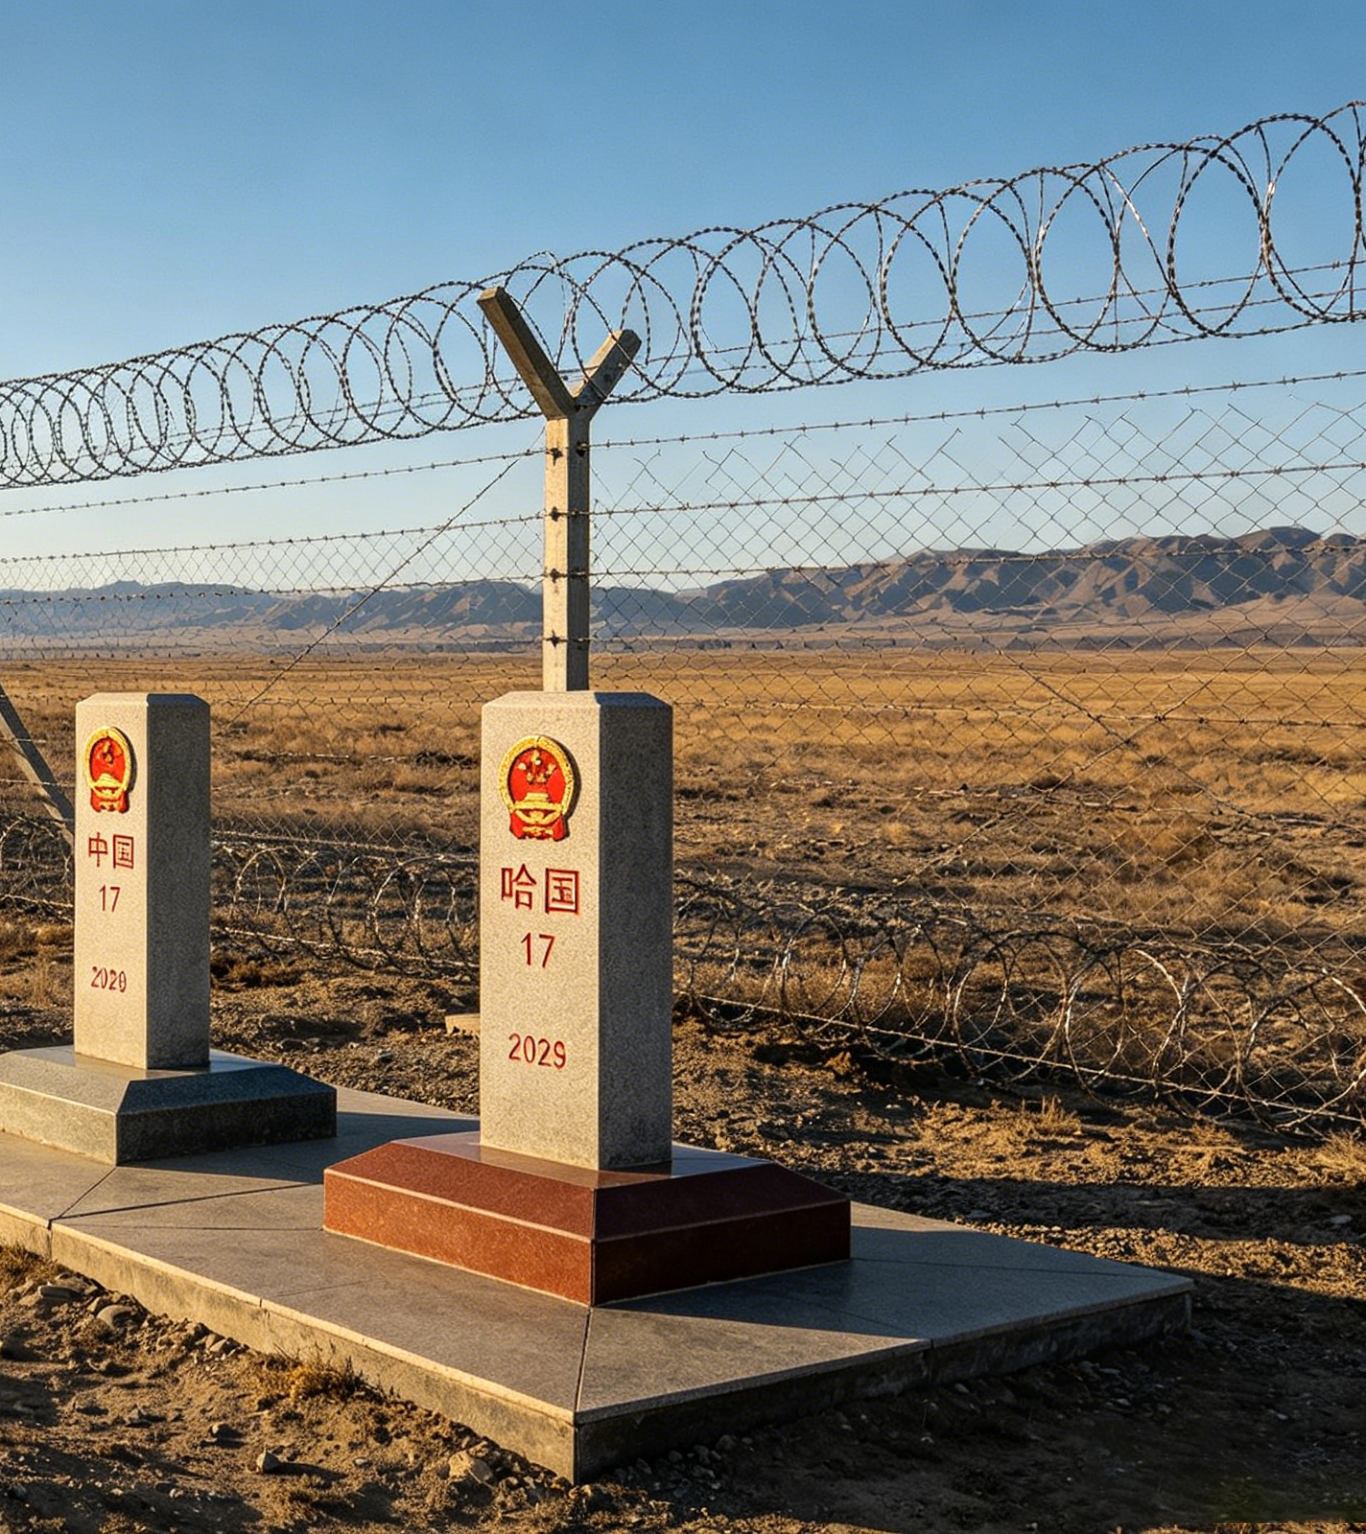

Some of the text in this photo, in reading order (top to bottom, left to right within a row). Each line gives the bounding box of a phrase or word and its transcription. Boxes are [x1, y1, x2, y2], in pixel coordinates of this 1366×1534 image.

[88, 832, 134, 869] 中国
[99, 885, 120, 912] 17
[501, 863, 580, 915] 哈国
[521, 932, 556, 968] 17
[508, 1033, 567, 1070] 2029
